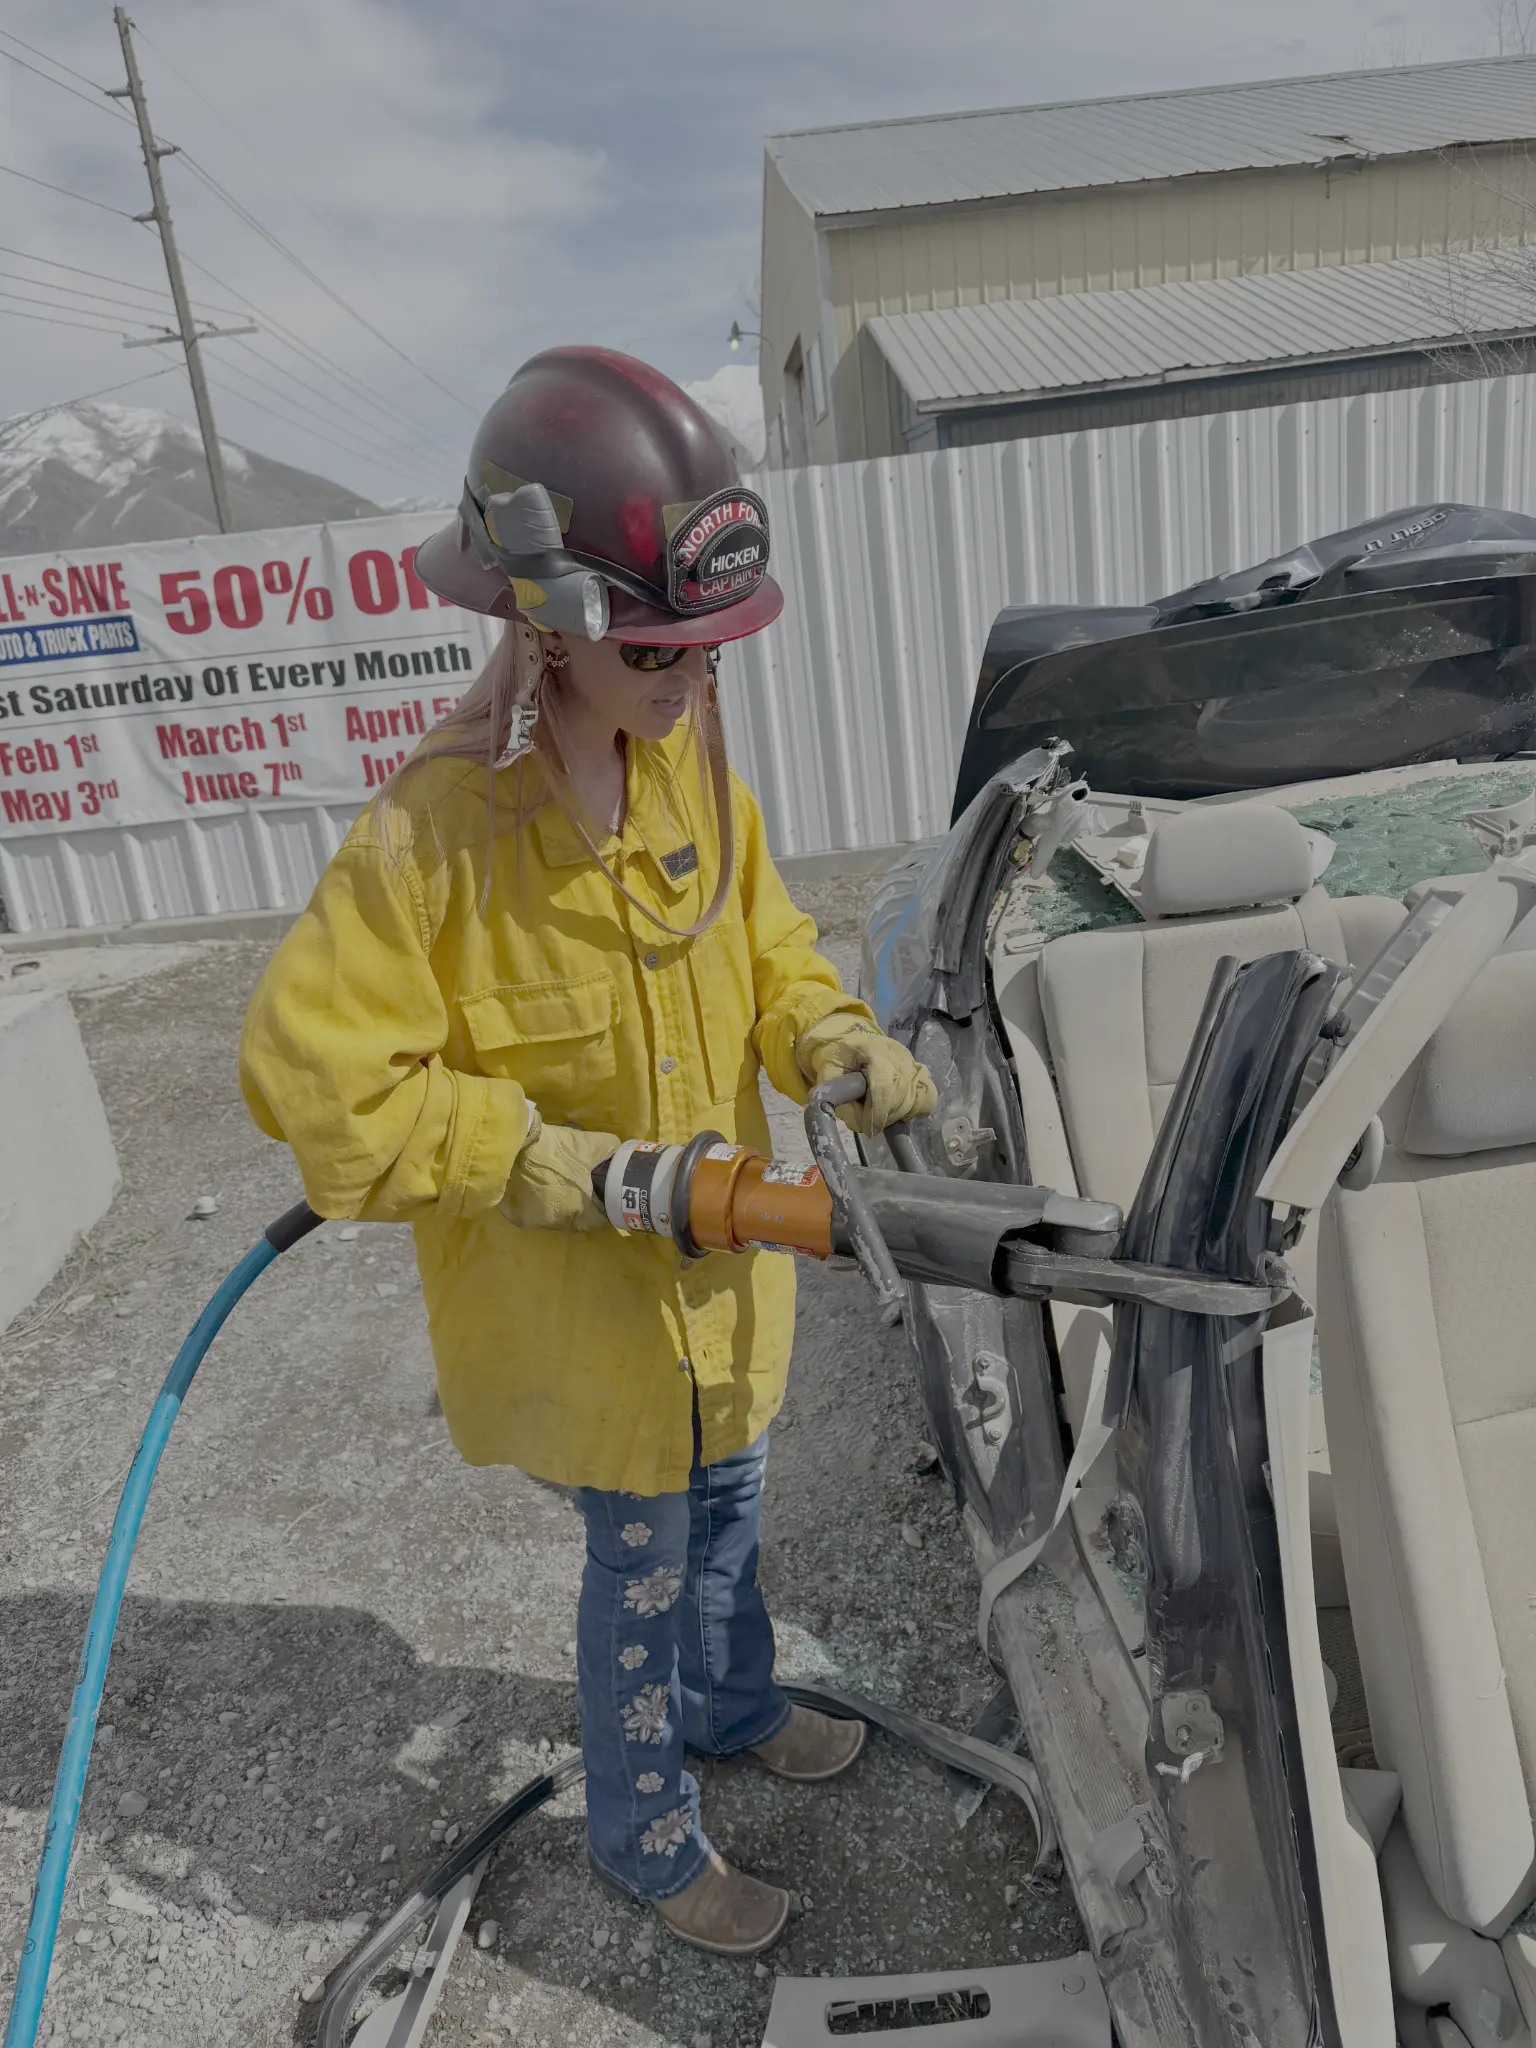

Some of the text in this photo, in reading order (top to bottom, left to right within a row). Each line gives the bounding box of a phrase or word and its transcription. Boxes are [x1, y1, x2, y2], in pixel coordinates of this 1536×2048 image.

[680, 502, 733, 560] NORTH
[1365, 538, 1383, 552] LT
[710, 544, 760, 574] HICKEN
[159, 546, 456, 635] 50% Of
[700, 567, 752, 597] CAPTAIN
[23, 631, 39, 658] &
[36, 625, 89, 656] TRUCK
[87, 620, 135, 651] PARTS
[29, 674, 193, 715] Saturday
[202, 665, 239, 697] Of
[247, 659, 346, 692] Every
[354, 643, 472, 681] Month
[155, 712, 308, 760] March 1st
[345, 700, 426, 743] April
[0, 733, 101, 777] Feb 1st
[0, 779, 119, 823] May 3rd
[182, 761, 303, 805] June 7th
